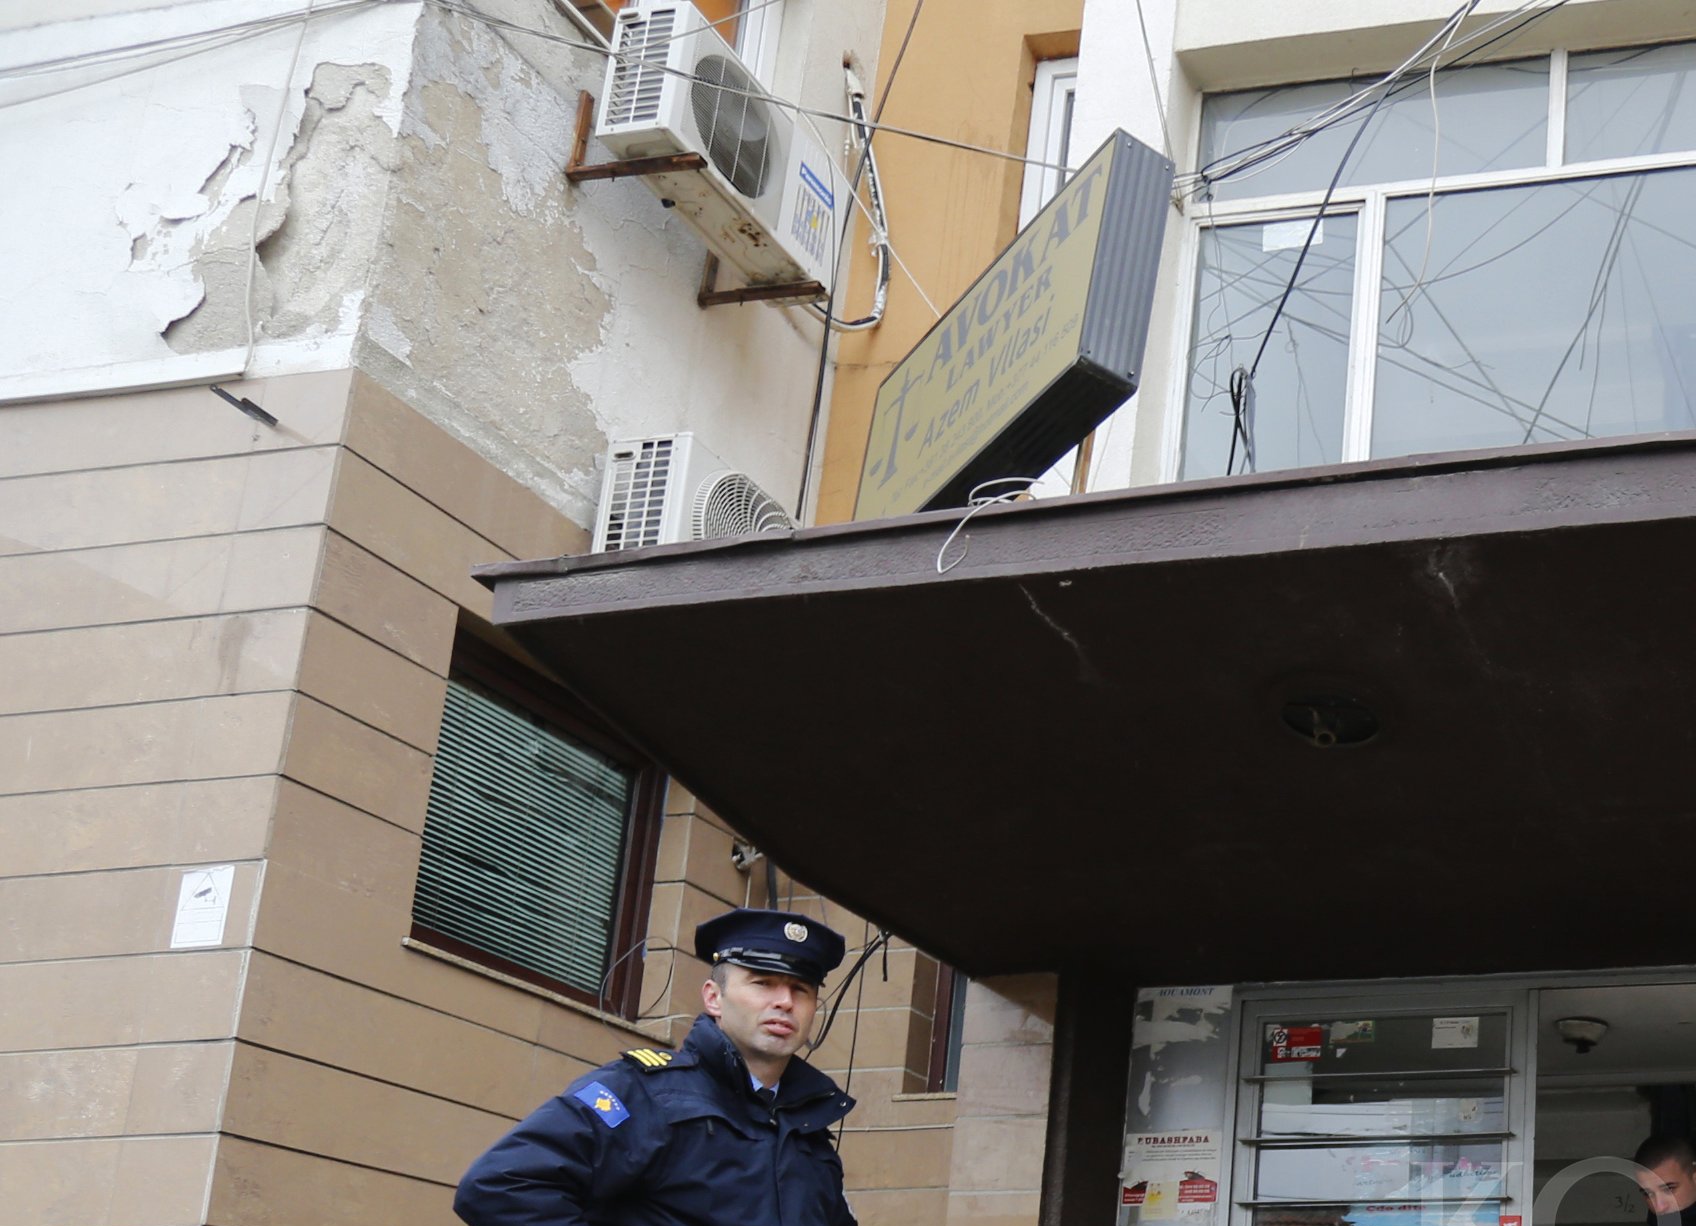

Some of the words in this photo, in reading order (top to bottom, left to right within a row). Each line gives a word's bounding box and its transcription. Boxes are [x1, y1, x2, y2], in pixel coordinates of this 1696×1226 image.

[924, 163, 1102, 386] AVOKAT
[946, 266, 1055, 393] LAWYER
[917, 377, 980, 459] Azem
[988, 293, 1054, 388] Vllasi
